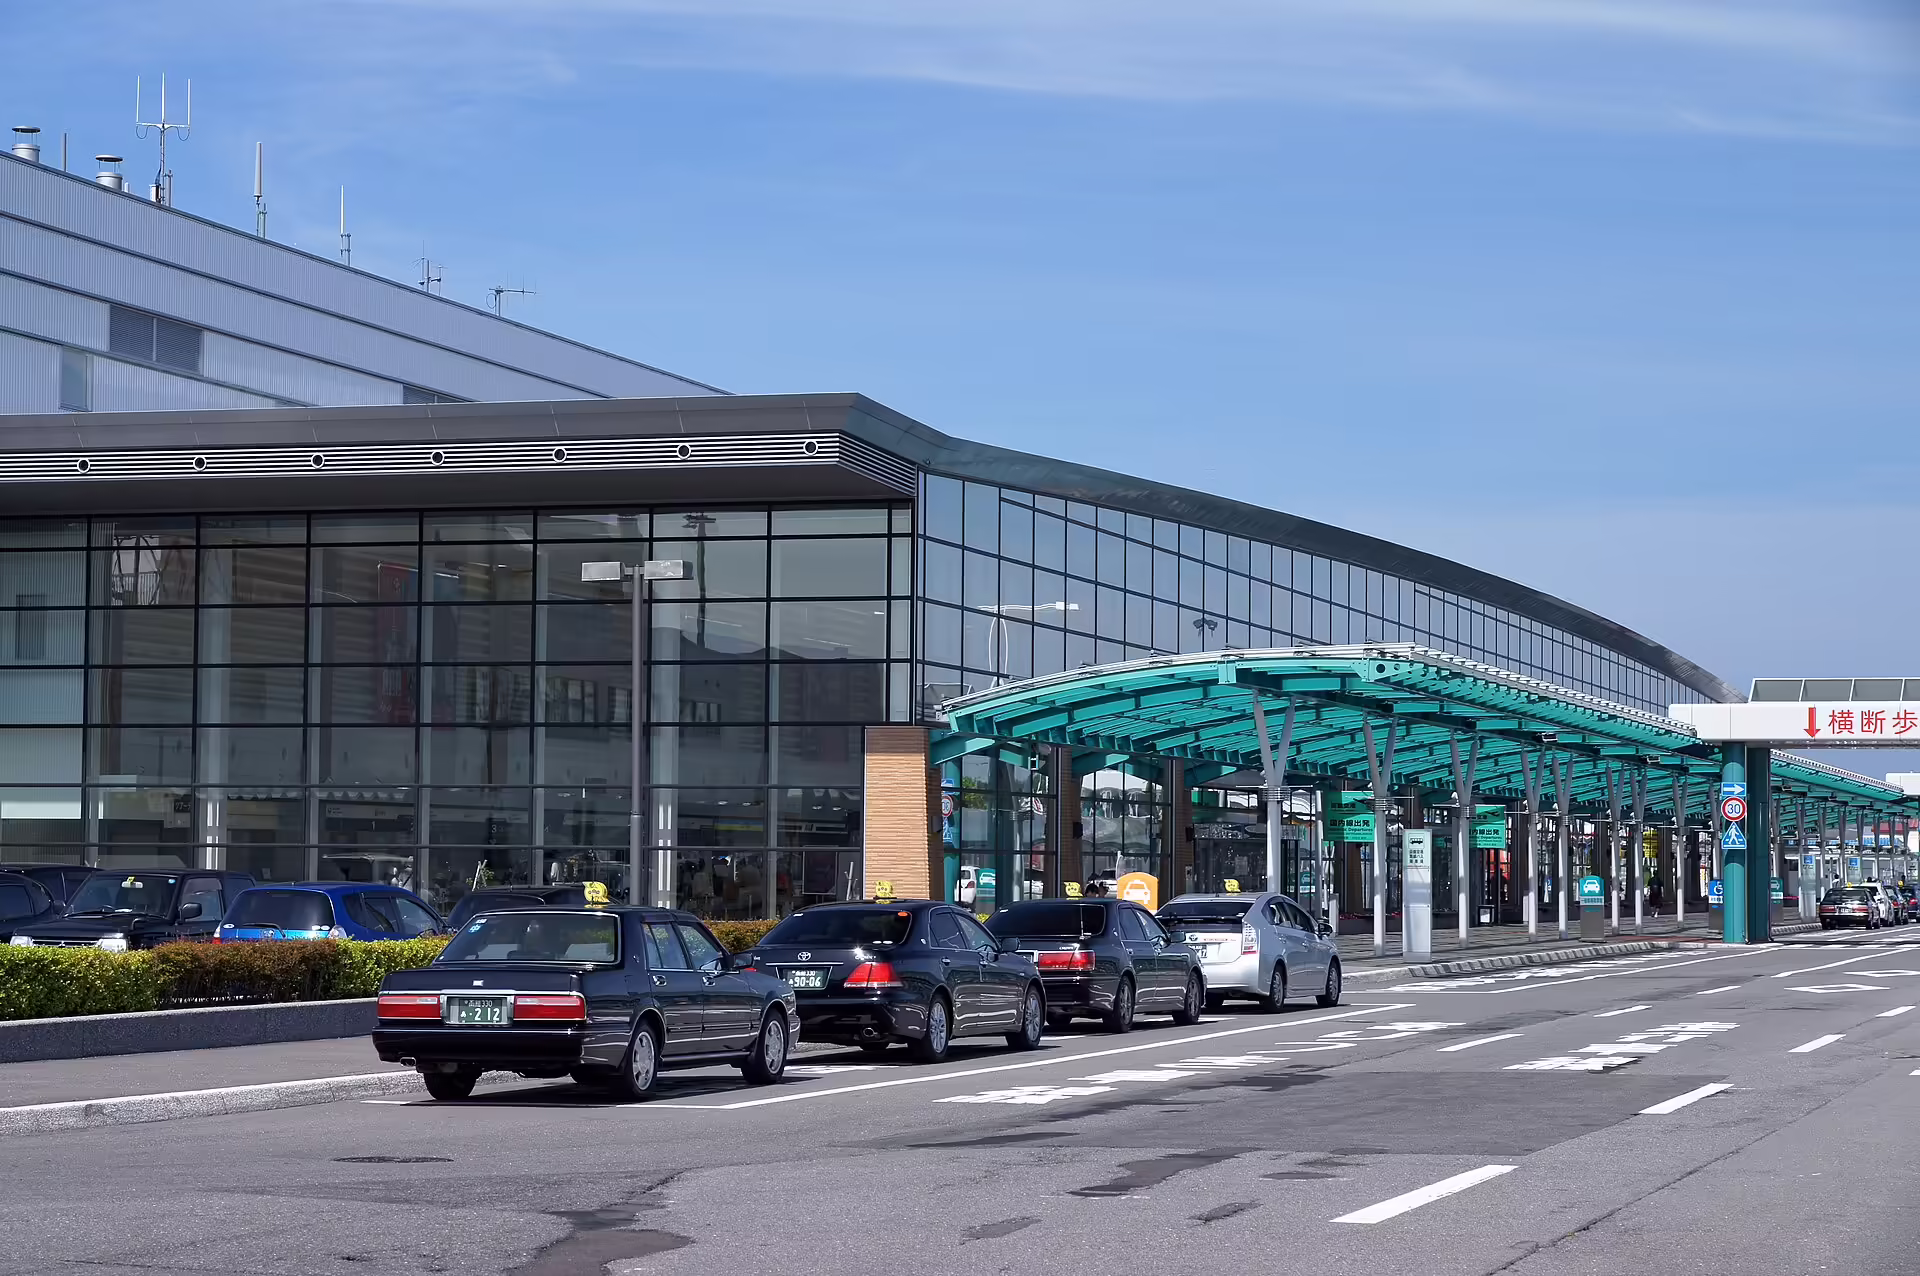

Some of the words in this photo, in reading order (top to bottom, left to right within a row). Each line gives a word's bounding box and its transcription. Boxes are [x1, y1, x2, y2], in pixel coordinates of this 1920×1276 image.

[1828, 709, 1918, 734] 横断歩
[1727, 803, 1741, 815] 30
